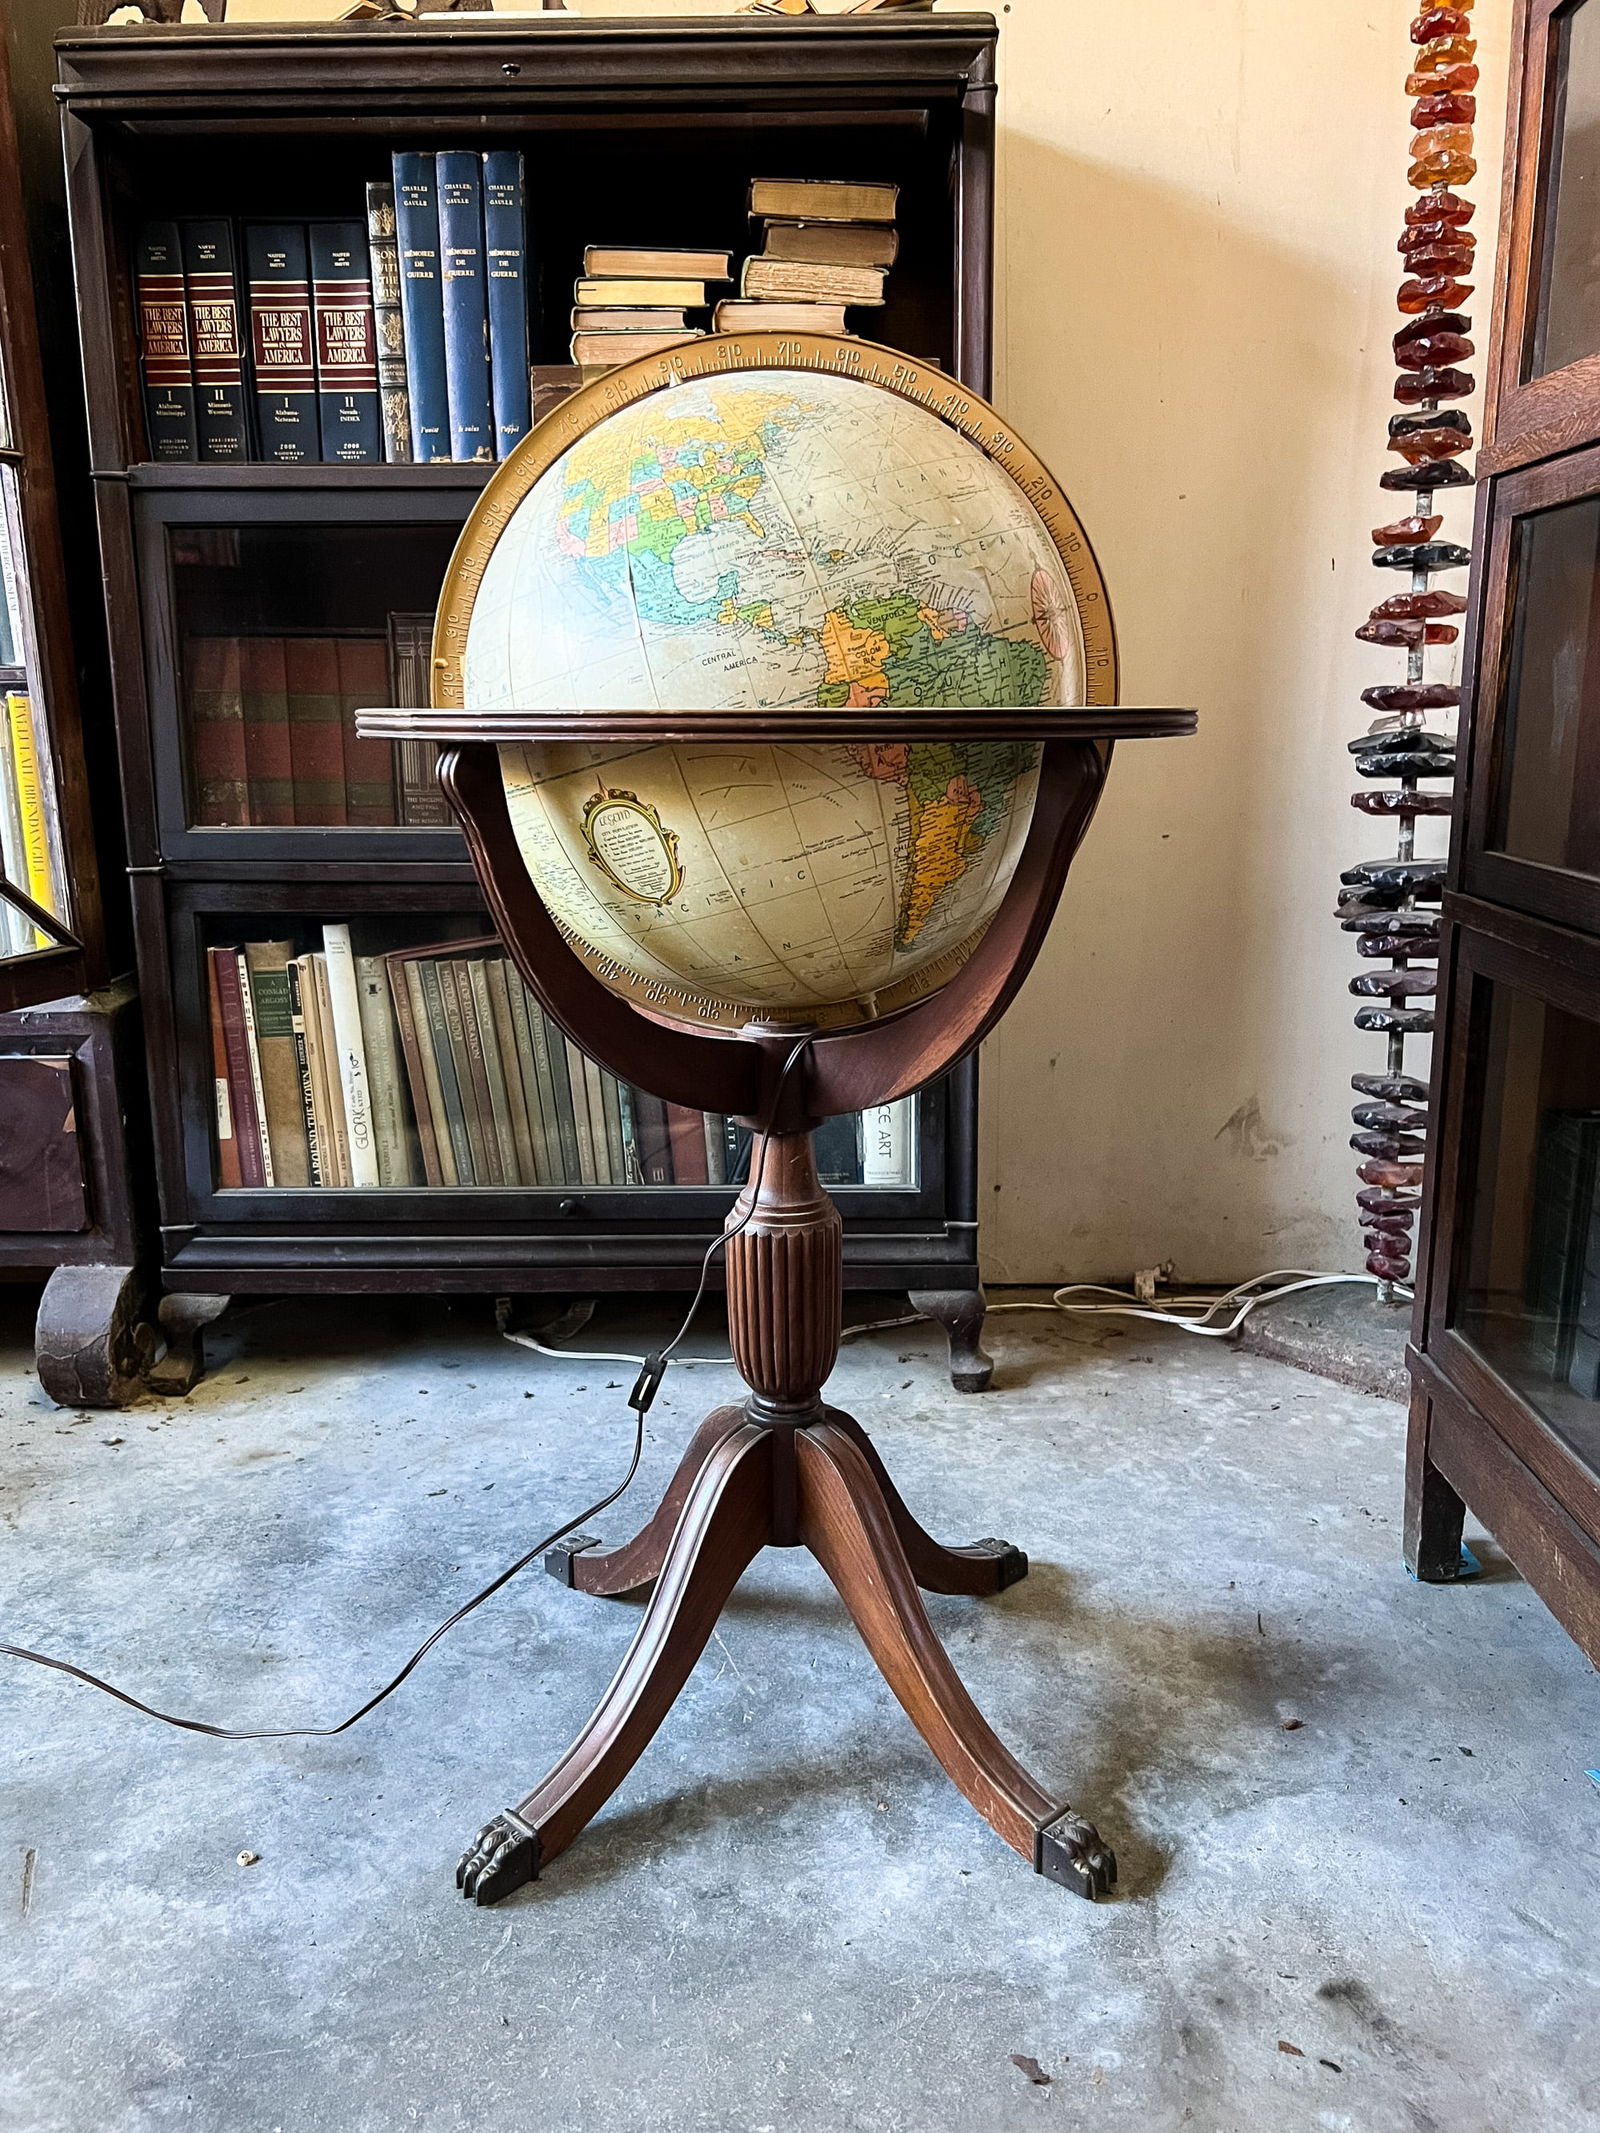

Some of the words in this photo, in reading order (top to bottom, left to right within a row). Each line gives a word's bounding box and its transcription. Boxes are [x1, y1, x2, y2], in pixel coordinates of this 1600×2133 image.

[144, 308, 162, 320] THE
[162, 308, 182, 320] BEST
[193, 306, 211, 320] THE
[211, 306, 232, 319] BEST
[260, 313, 279, 327] THE
[279, 313, 302, 327] BEST
[324, 312, 343, 327] THE
[344, 311, 366, 327] BEST
[146, 321, 183, 334] LAWYERS
[196, 319, 232, 333] LAWYERS
[326, 326, 366, 341] LAWYERS
[262, 327, 302, 342] LAWYERS
[148, 341, 184, 354] AMERICA
[198, 339, 234, 353] AMERICA
[263, 349, 303, 364] AMERICA
[327, 348, 367, 363] AMERICA
[866, 608, 908, 627] VENEZUELA
[701, 650, 737, 667] CENTRAL
[723, 655, 759, 673] AMERICA
[599, 809, 630, 827] LEGEND
[222, 968, 240, 1025] VILLA
[258, 988, 289, 996] CONRAD
[425, 969, 437, 999] EARLY
[431, 1001, 444, 1031] ISLAM
[441, 970, 458, 1014] HISTORIC
[450, 1014, 463, 1041] INDIA
[401, 1007, 413, 1042] AMERICA
[464, 1001, 481, 1060] EXPLORATION
[531, 1002, 547, 1072] ENLIGHTENMENT
[227, 1033, 247, 1085] TABLE
[877, 1129, 892, 1159] ART
